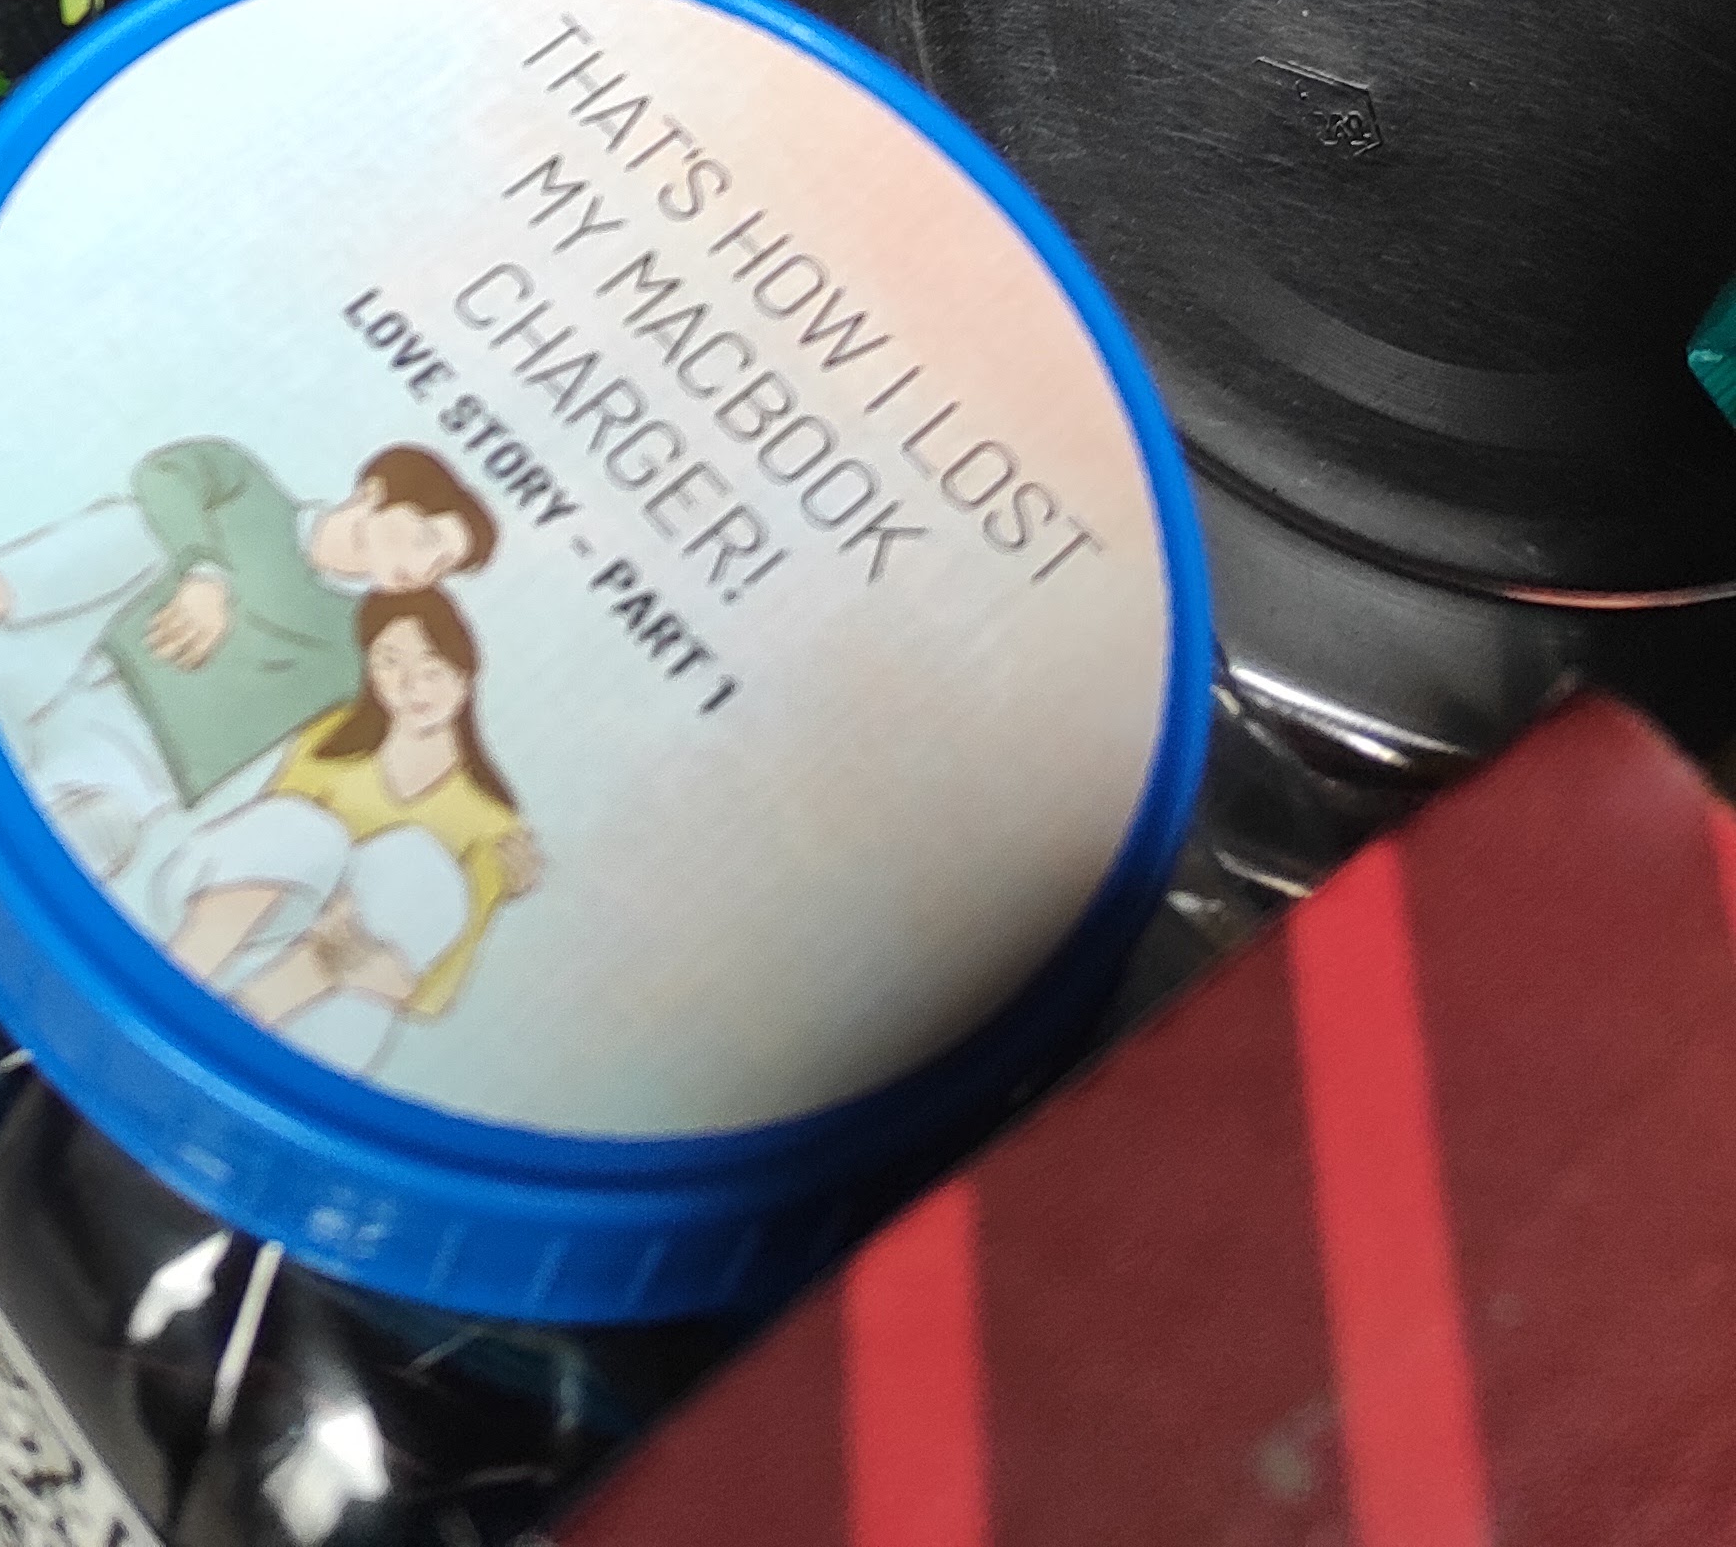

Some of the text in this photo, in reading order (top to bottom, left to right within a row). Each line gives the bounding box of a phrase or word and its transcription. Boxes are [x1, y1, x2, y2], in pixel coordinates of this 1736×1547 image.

[342, 285, 464, 408] LOVE
[439, 393, 580, 529] STORY
[591, 555, 718, 681] PART
[698, 673, 744, 716] 1
[452, 259, 794, 607] CHARGER!
[501, 153, 932, 586] MY MACBOOK
[521, 12, 1104, 584] THAT'S HOW I LOST
